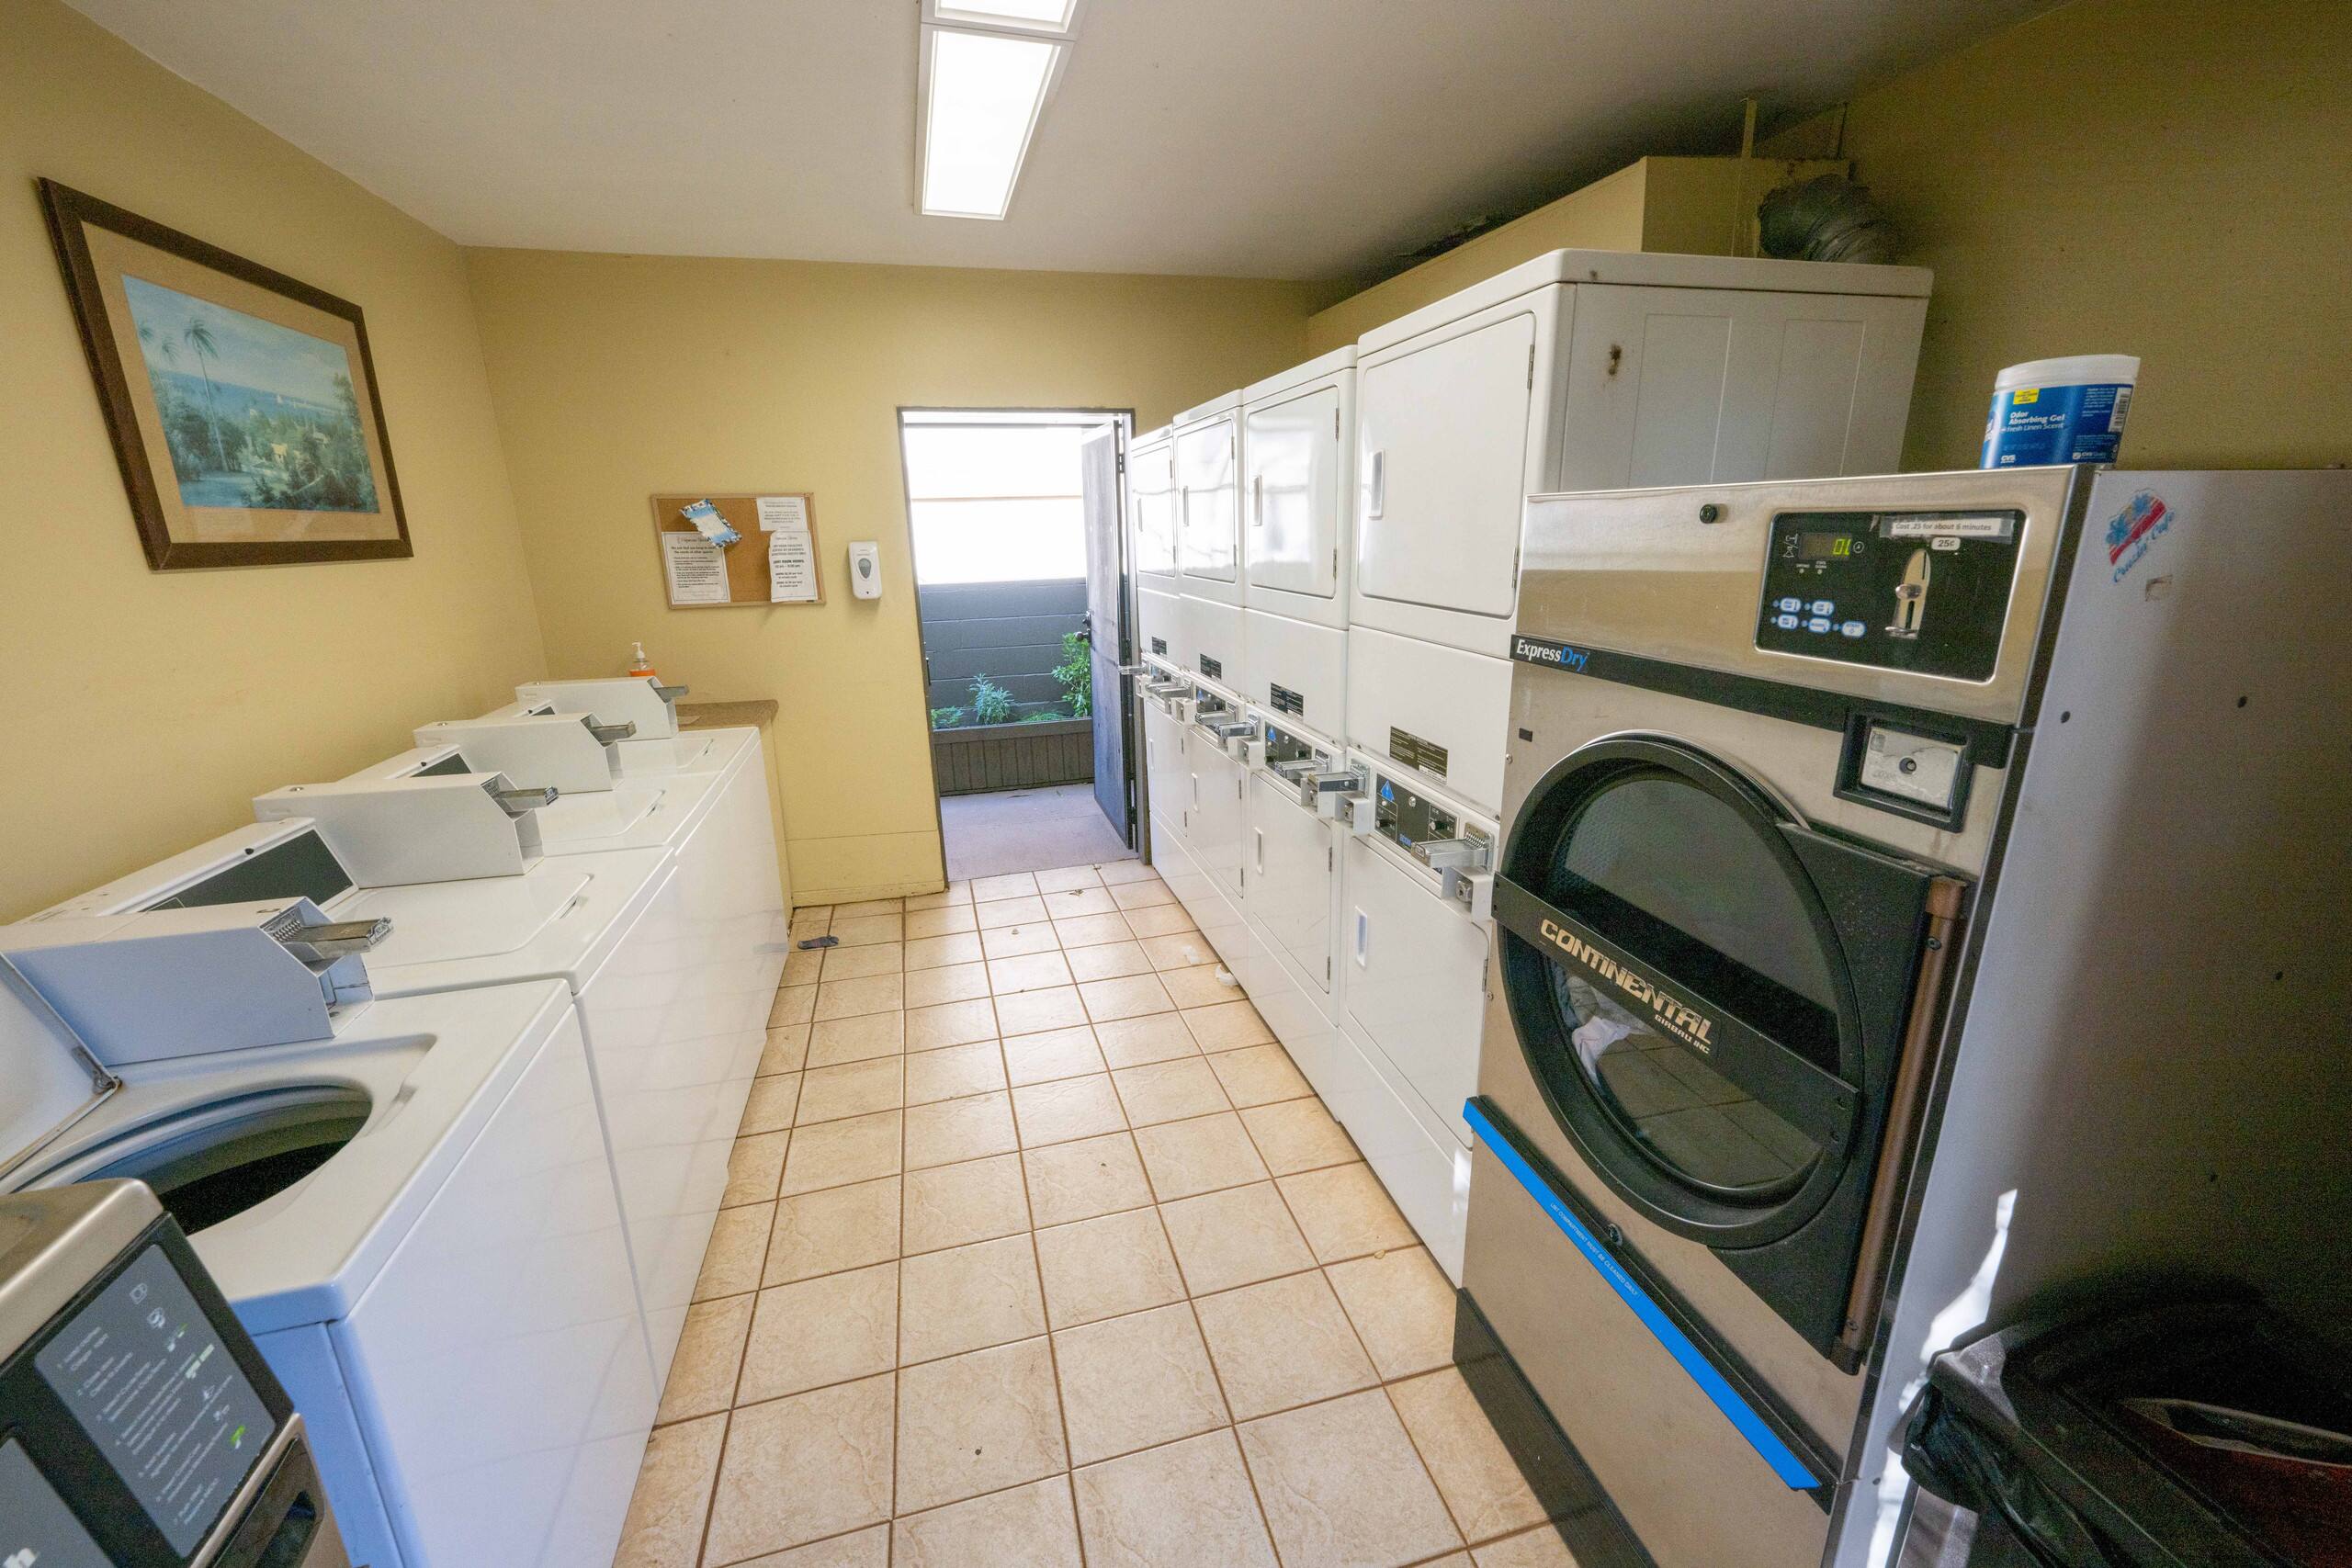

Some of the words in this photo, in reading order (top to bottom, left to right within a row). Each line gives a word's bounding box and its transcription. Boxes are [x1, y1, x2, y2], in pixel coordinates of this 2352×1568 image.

[2008, 415, 2049, 425] Absorbing
[2050, 413, 2065, 422] Gel
[2010, 411, 2029, 419] Odor
[2024, 423, 2042, 432] Linen
[1922, 522, 1933, 530] for
[1934, 522, 1955, 530] about
[1516, 638, 1589, 672] ExpressDry
[1541, 919, 1713, 1044] CONTINENTAL
[1654, 1013, 1694, 1043] GIRBAU
[1693, 1039, 1711, 1055] INC
[1558, 1211, 1589, 1243] COMPARTMENT
[1604, 1259, 1627, 1284] CLEANED
